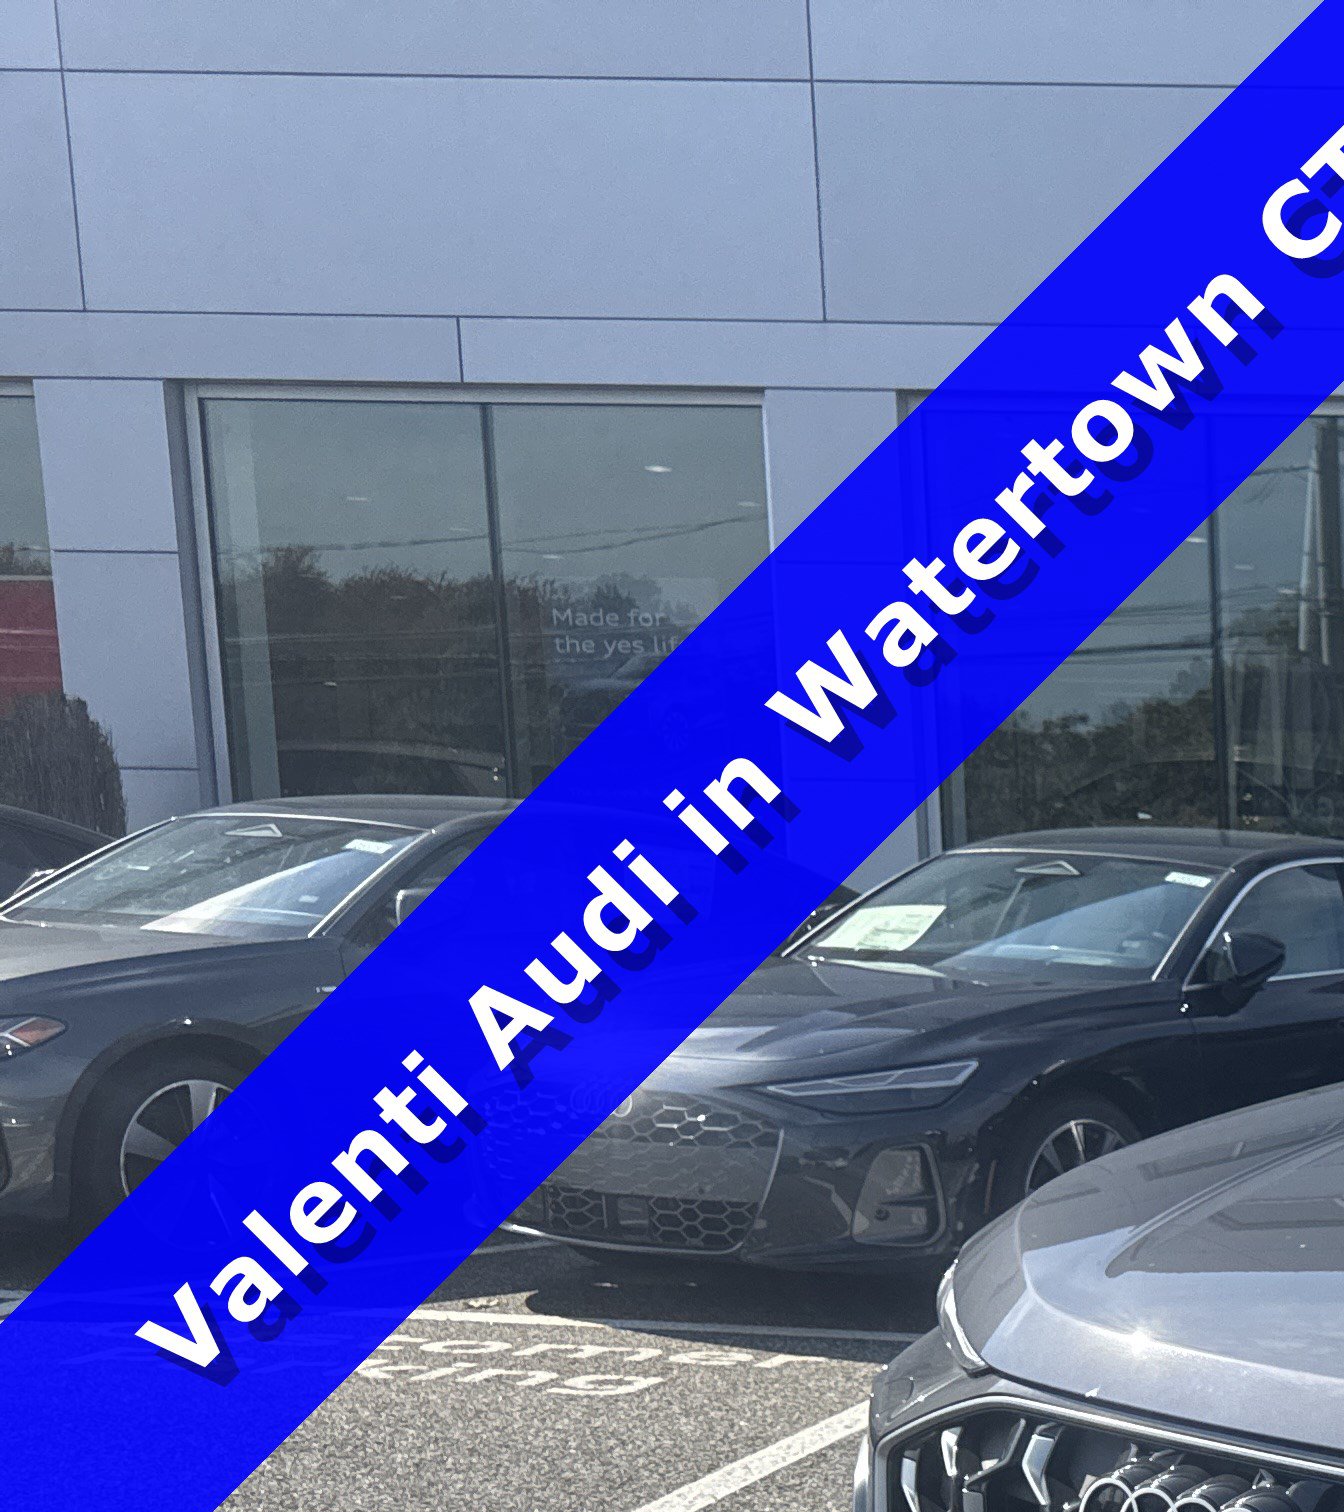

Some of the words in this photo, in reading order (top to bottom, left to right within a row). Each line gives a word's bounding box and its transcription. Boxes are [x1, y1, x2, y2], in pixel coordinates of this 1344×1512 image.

[552, 607, 619, 628] Made
[627, 607, 666, 628] for
[555, 635, 596, 655] the
[603, 639, 645, 658] yes
[654, 635, 681, 655] lif
[376, 1334, 826, 1369] tomer
[352, 1358, 667, 1397] king
